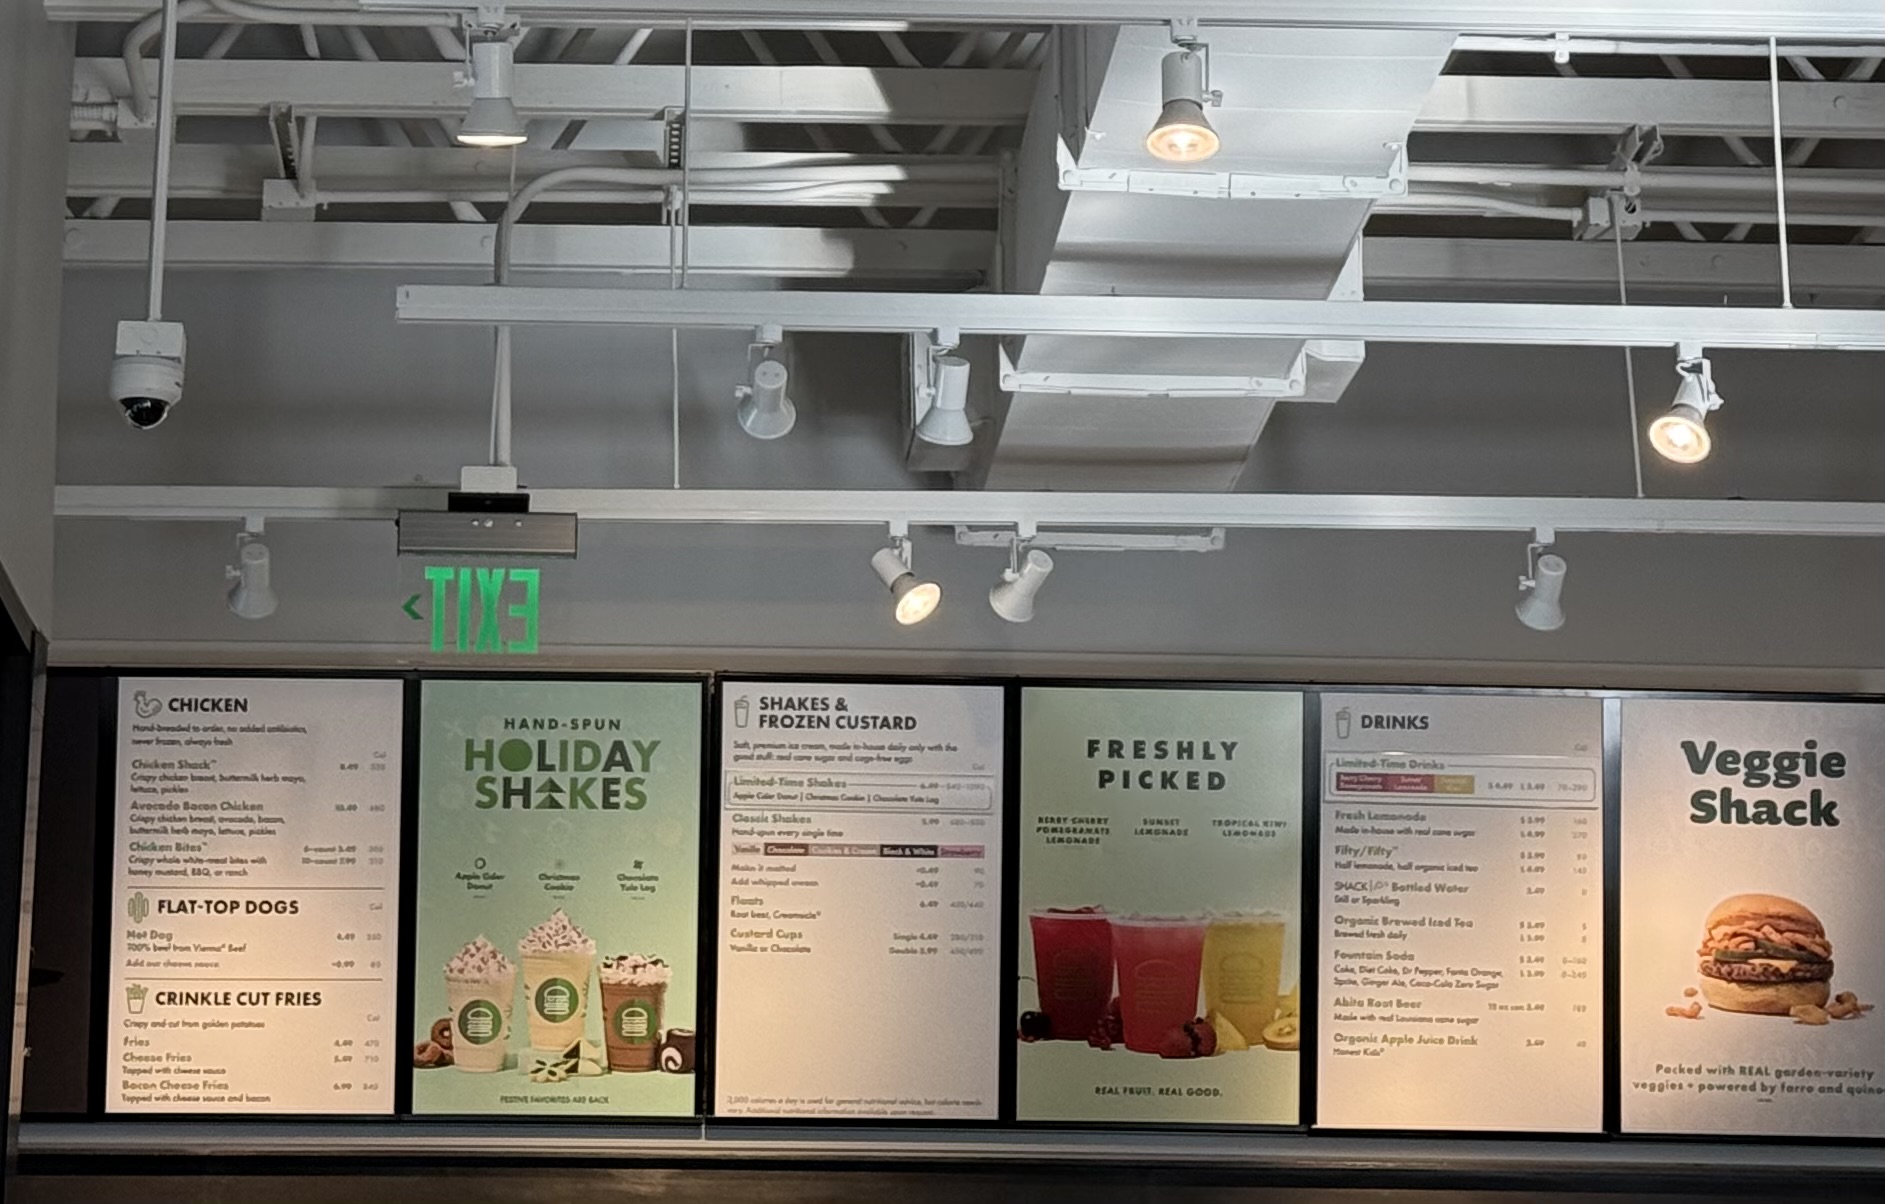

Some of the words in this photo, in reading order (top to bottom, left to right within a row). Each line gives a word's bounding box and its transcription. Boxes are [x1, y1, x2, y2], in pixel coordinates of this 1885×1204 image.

[169, 698, 248, 713] CHICKEN
[759, 697, 830, 711] SHAKES
[835, 698, 848, 712] &
[504, 718, 621, 731] HAND-SPUN
[759, 715, 830, 729] FROZEN
[836, 716, 916, 730] CUSTARD
[1361, 715, 1429, 730] DRINKS
[465, 739, 661, 772] HOLIDAY
[1087, 739, 1238, 760] FRESHLY
[1336, 759, 1406, 769] Limited-Time
[1409, 760, 1445, 770] Drinks
[1681, 740, 1846, 788] Veggie
[734, 777, 804, 787] Limited-Time
[807, 778, 846, 788] Shakes
[1099, 770, 1226, 790] PICKED
[475, 776, 647, 810] SHAKES
[131, 802, 179, 811] Avocado
[183, 802, 217, 811] Bacon
[220, 802, 263, 811] Chicken
[1690, 787, 1840, 826] Shack
[732, 814, 768, 823] Classic
[771, 814, 811, 824] Shakes
[1335, 811, 1365, 820] Fresh
[1368, 811, 1426, 822] Lemonade
[1392, 882, 1431, 892] Bottled
[1434, 883, 1469, 893] Water
[158, 900, 240, 914] FLAT-TOP
[245, 900, 299, 914] DOGS
[1334, 916, 1378, 927] Organic
[1382, 916, 1425, 927] Brewed
[1429, 917, 1451, 927] Iced
[1454, 918, 1473, 928] Tea
[730, 929, 773, 939] Custard
[776, 930, 802, 940] Cups
[1334, 951, 1383, 960] Fountain
[1386, 951, 1414, 961] Soda
[156, 992, 231, 1005] CRINKLE
[236, 992, 270, 1006] CUT
[275, 992, 322, 1005] FRIES
[123, 1037, 150, 1046] Fries
[1334, 1033, 1378, 1044] Organic
[1381, 1034, 1414, 1046] Apple
[1417, 1035, 1444, 1045] Juice
[1447, 1035, 1478, 1045] Drink
[123, 1053, 162, 1062] Cheese
[166, 1053, 191, 1062] Fries
[1656, 1065, 1701, 1074] Packed
[1706, 1065, 1735, 1075] with
[1740, 1066, 1770, 1076] REAL
[1775, 1068, 1874, 1079] garden-variety
[122, 1081, 156, 1090] Bacon
[160, 1082, 199, 1090] Cheese
[203, 1082, 229, 1090] Fries
[1095, 1087, 1119, 1095] REAL
[1123, 1087, 1154, 1096] FRUIT.
[1159, 1087, 1182, 1096] REAL
[1186, 1088, 1223, 1097] GOOD.
[1632, 1082, 1683, 1092] veggies
[1698, 1082, 1756, 1093] powered
[1761, 1083, 1776, 1094] by
[1781, 1083, 1813, 1093] farro
[1818, 1084, 1842, 1093] and
